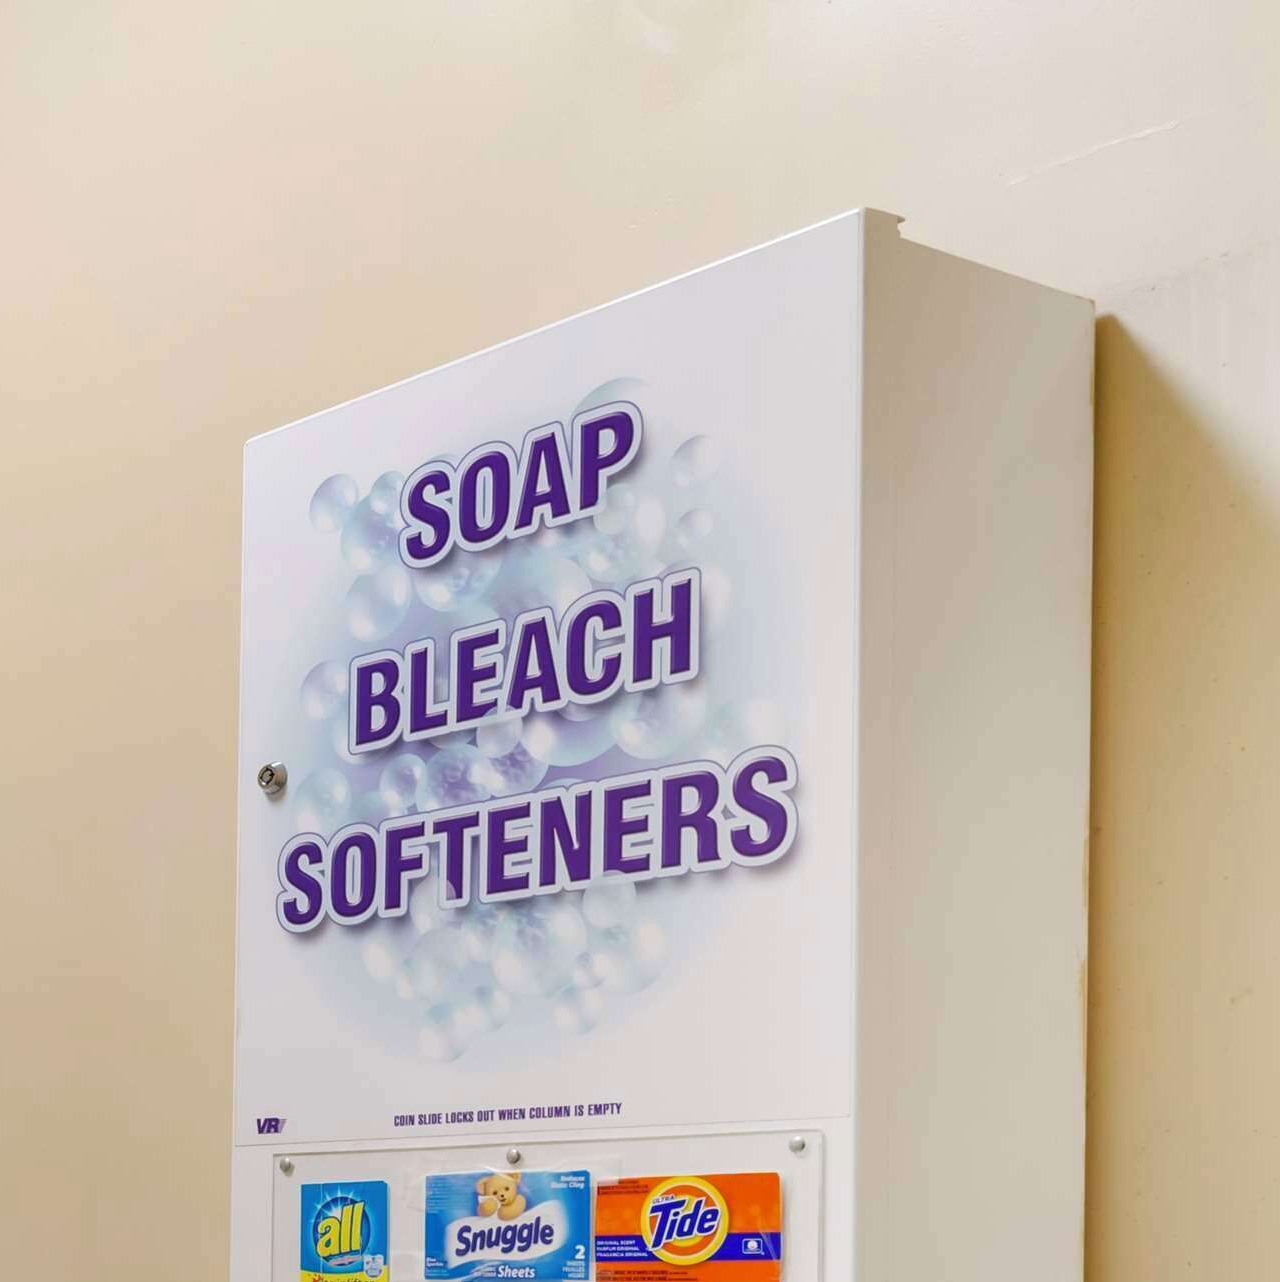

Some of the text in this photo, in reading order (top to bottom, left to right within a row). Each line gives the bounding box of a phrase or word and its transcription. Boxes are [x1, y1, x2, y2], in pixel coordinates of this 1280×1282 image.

[402, 407, 637, 562] SOAP
[352, 575, 694, 749] BLEACH
[280, 753, 790, 928] SOFTENERS
[394, 1102, 622, 1127] COIN SLIDE LOCKS OUT WHEN COLUMN IS EMPTY
[652, 1195, 675, 1205] ULTRA
[316, 1201, 365, 1257] all
[455, 1216, 554, 1257] Snuggle
[648, 1198, 720, 1250] Tide
[497, 1265, 536, 1279] Sheets
[574, 1244, 586, 1260] 2
